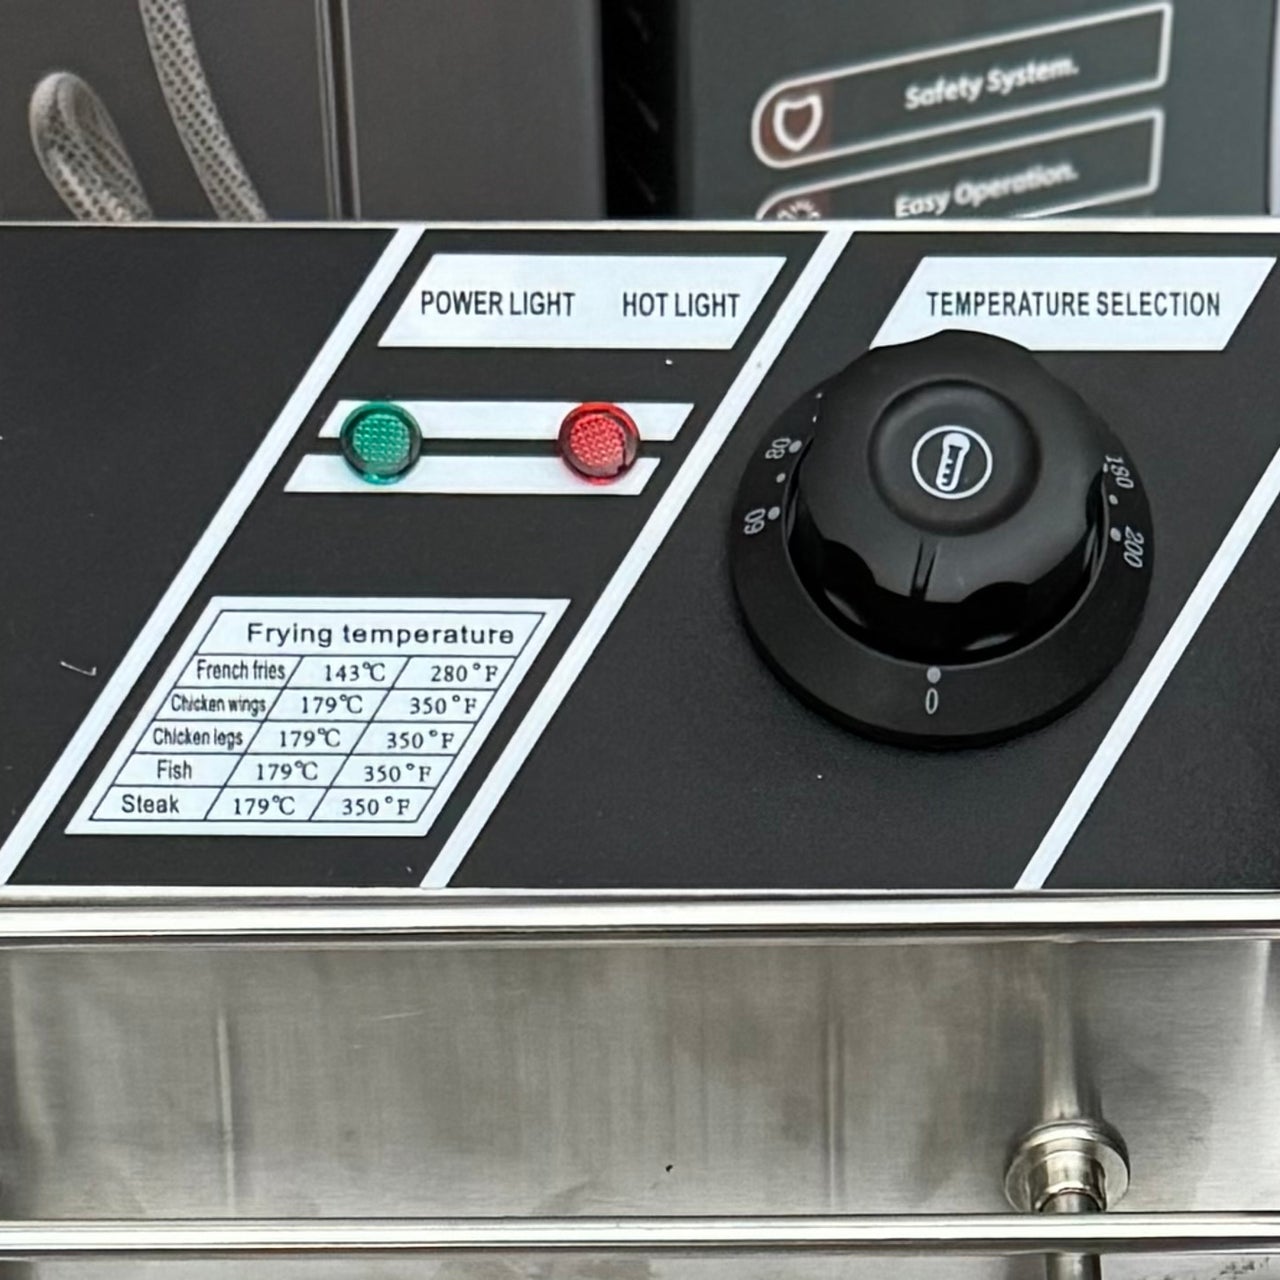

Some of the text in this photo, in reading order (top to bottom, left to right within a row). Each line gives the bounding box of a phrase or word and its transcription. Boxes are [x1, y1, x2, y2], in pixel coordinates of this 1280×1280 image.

[904, 56, 1079, 110] Safety System.
[895, 160, 1079, 219] Easy Operation.
[421, 290, 575, 317] POWER LIGHT
[622, 292, 740, 319] HOT LIGHT
[926, 290, 1220, 317] TEMPERATURE SELECTION
[765, 437, 792, 459] 80
[1104, 454, 1135, 489] 180
[743, 508, 766, 535] 60
[1123, 525, 1145, 569] 200
[247, 622, 514, 648] Frying temperature
[195, 658, 248, 680] French
[252, 658, 286, 680] fries
[171, 694, 224, 712] Chicken
[228, 696, 267, 717] wings
[926, 688, 939, 714] 0
[153, 728, 210, 746] Chicken
[213, 728, 243, 750] legs
[157, 759, 193, 780] Fish
[121, 794, 180, 814] Steak
